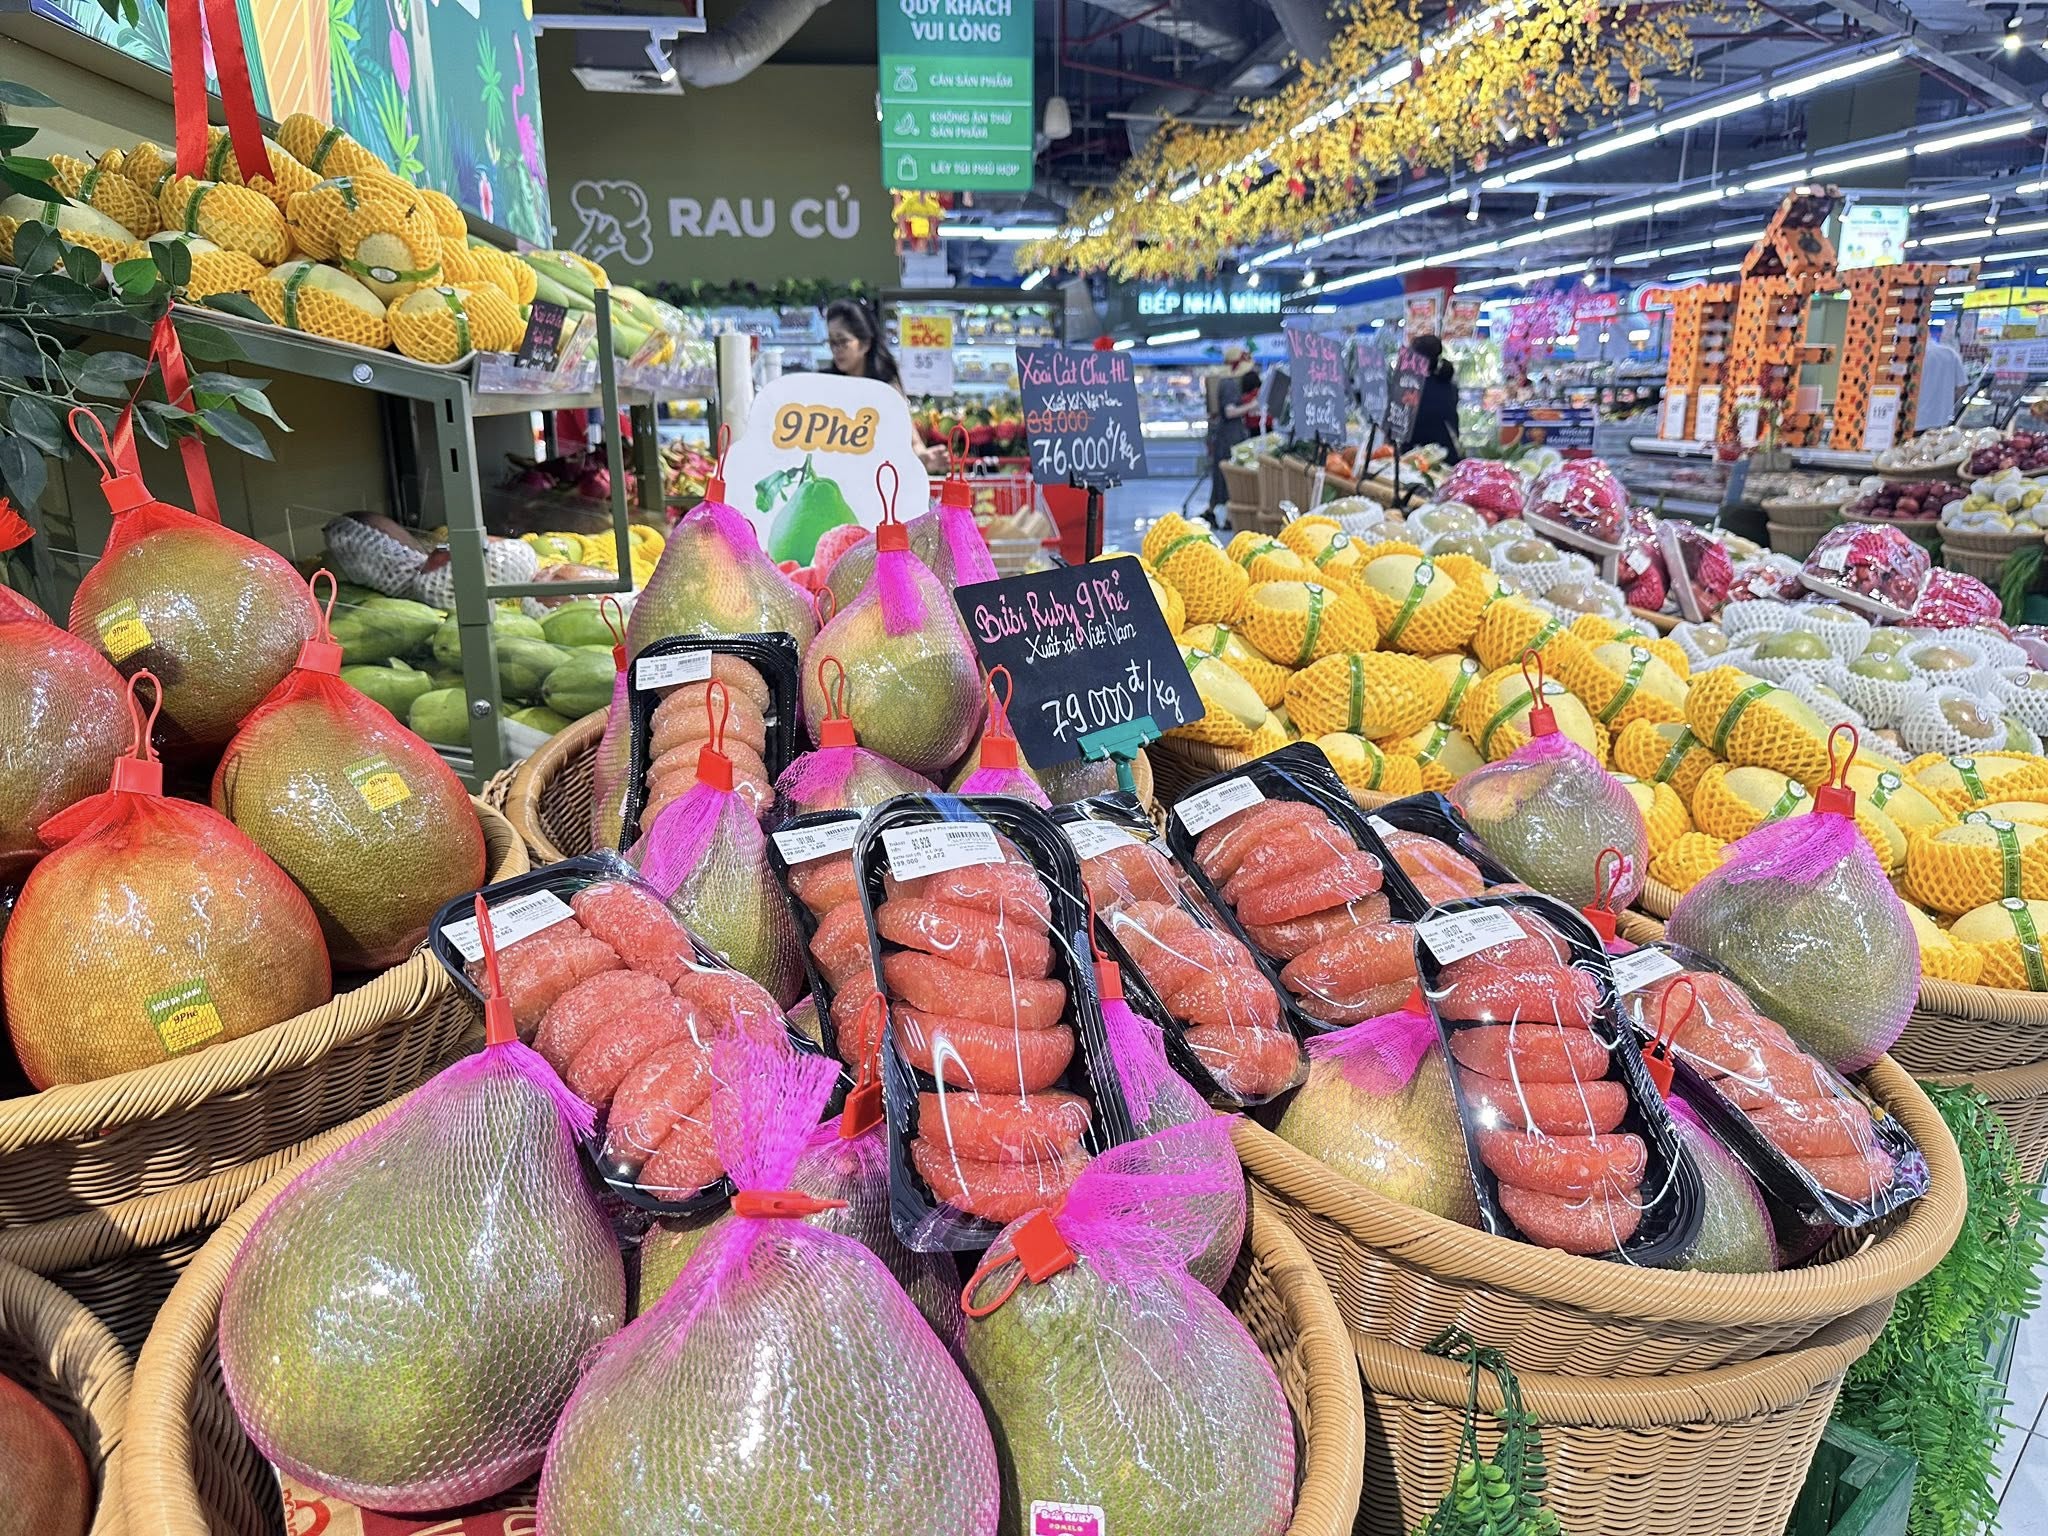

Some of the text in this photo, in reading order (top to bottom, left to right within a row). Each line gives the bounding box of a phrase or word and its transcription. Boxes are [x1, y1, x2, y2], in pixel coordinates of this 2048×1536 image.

[911, 18, 1001, 42] VUI LÒNG
[667, 184, 861, 240] RAU CỦ
[1053, 352, 1078, 386] Cát
[1110, 356, 1130, 384] HL
[1026, 590, 1084, 645] Ruby
[1106, 614, 1137, 645] Nam
